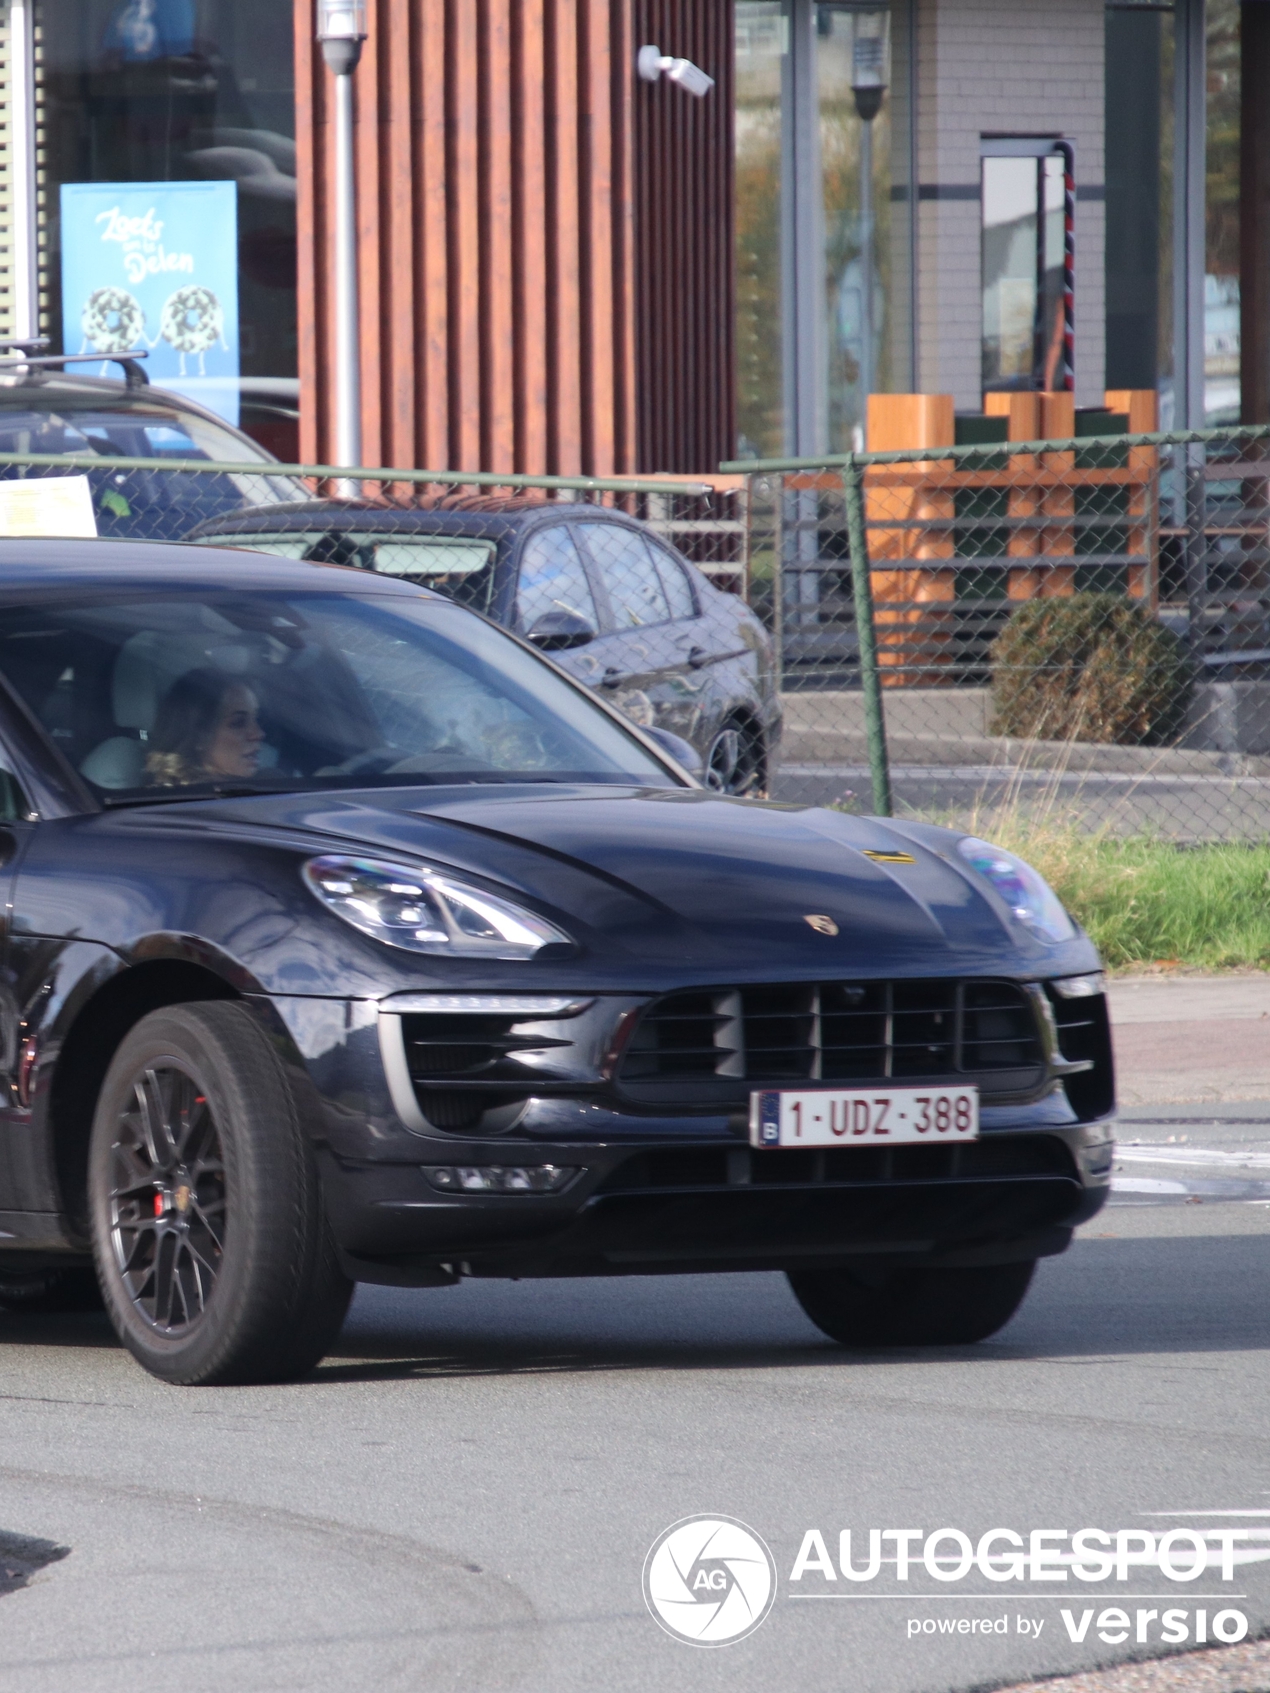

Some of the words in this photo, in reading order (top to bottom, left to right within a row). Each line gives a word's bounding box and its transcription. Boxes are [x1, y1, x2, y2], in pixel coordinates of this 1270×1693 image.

[94, 206, 165, 241] Zoets
[124, 244, 194, 285] Delen
[763, 1122, 778, 1140] B
[790, 1095, 972, 1137] 1-UDZ-388
